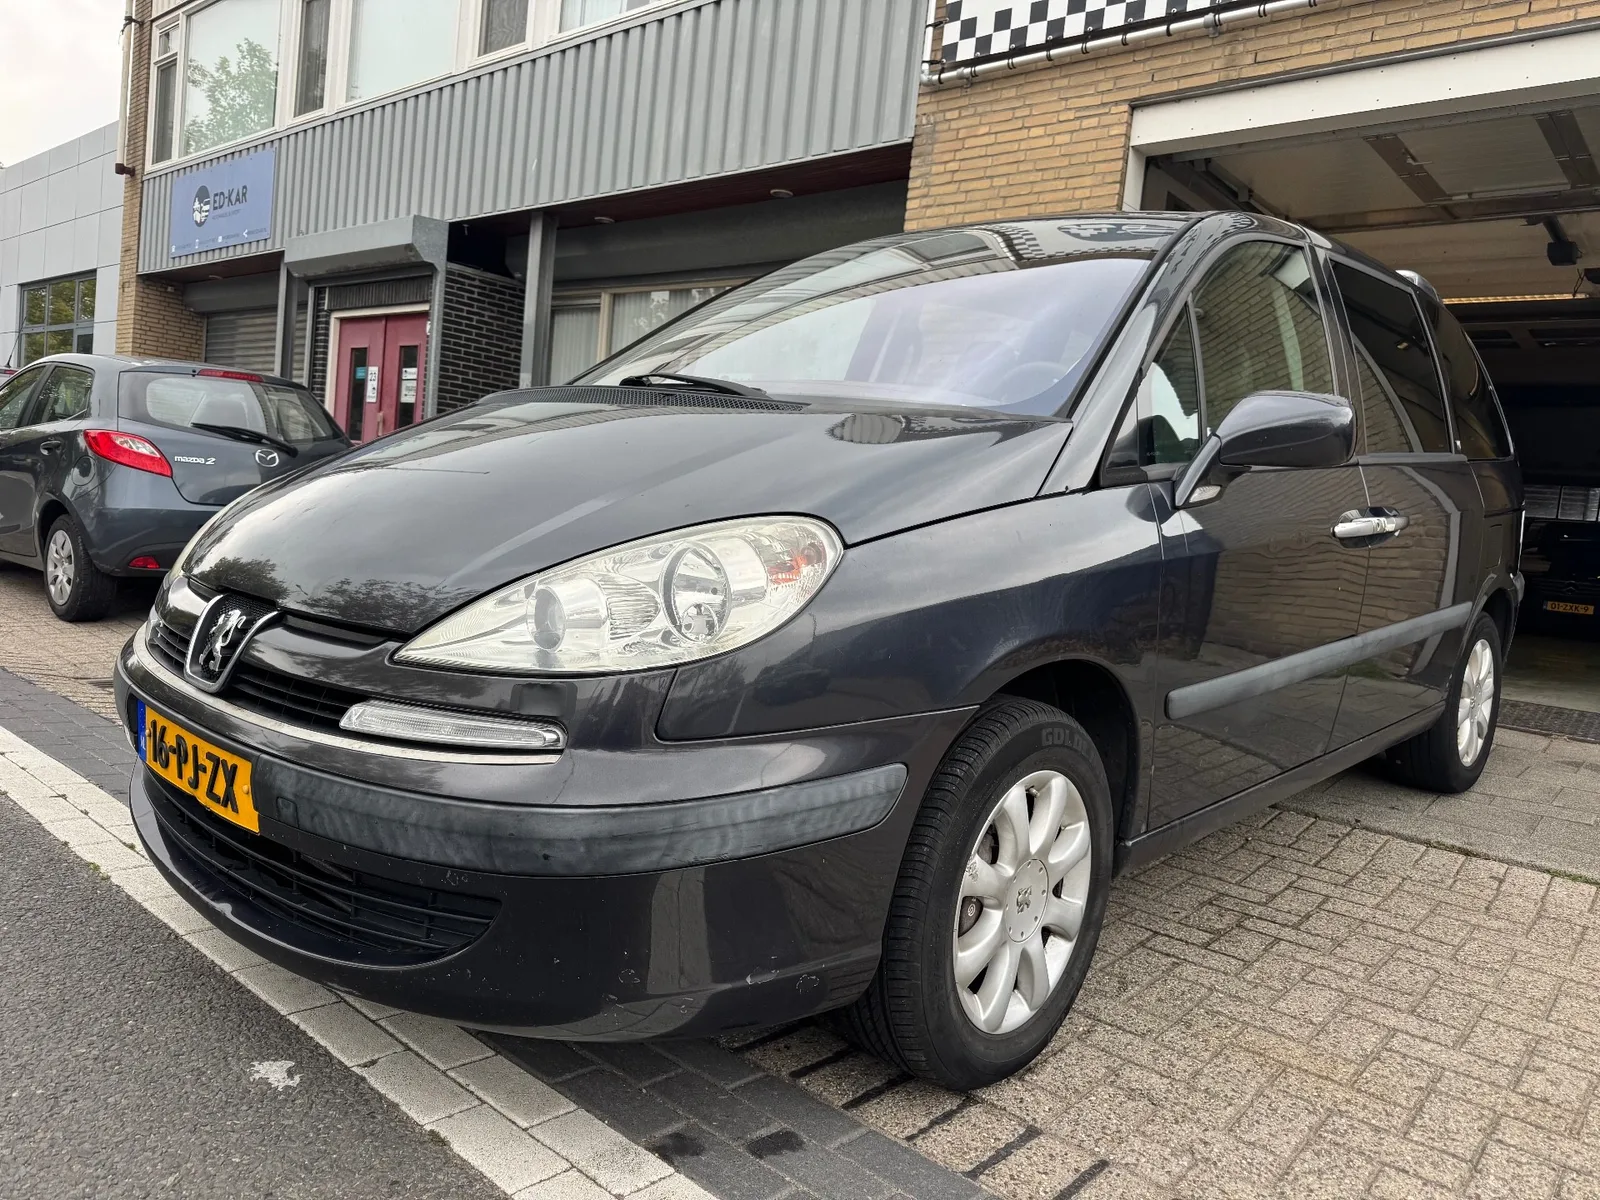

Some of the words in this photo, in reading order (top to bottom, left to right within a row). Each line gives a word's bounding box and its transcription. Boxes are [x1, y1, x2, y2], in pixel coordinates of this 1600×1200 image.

[174, 455, 205, 464] mazda
[205, 457, 217, 465] 2
[1550, 602, 1589, 613] 01-ZXK-9
[151, 719, 239, 814] 16-PJ-ZX
